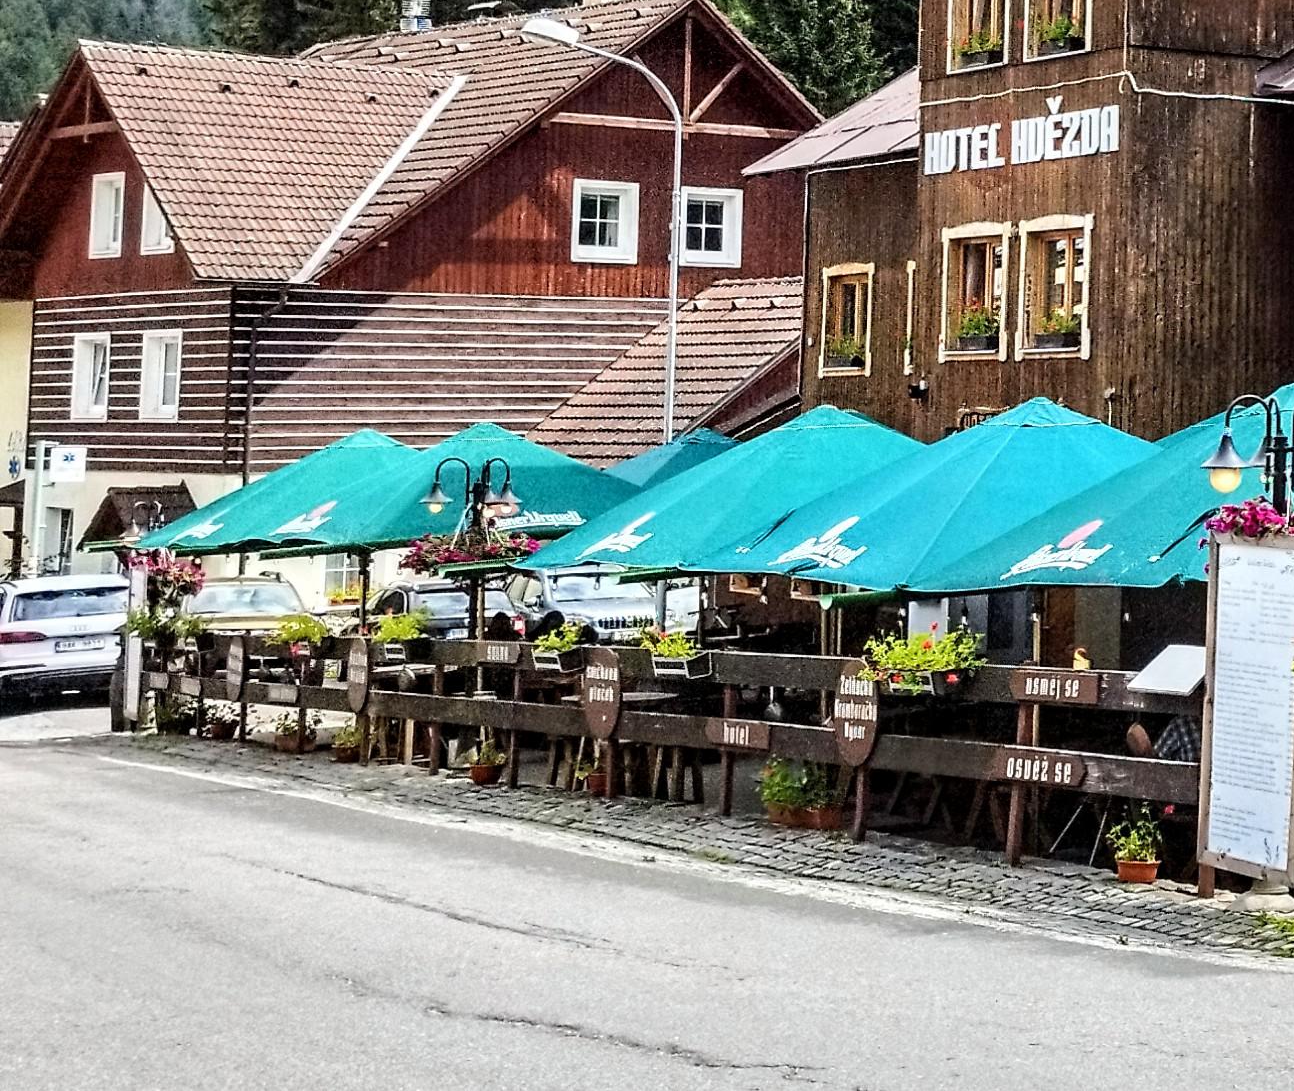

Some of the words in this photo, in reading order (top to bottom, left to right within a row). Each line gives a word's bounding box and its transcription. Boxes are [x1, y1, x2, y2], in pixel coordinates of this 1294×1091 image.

[924, 123, 1005, 175] HOTEL
[1025, 675, 1061, 700] usměj
[1065, 679, 1080, 698] se
[723, 723, 750, 746] hotel
[1006, 755, 1049, 782] osvěž
[1054, 762, 1072, 784] se
